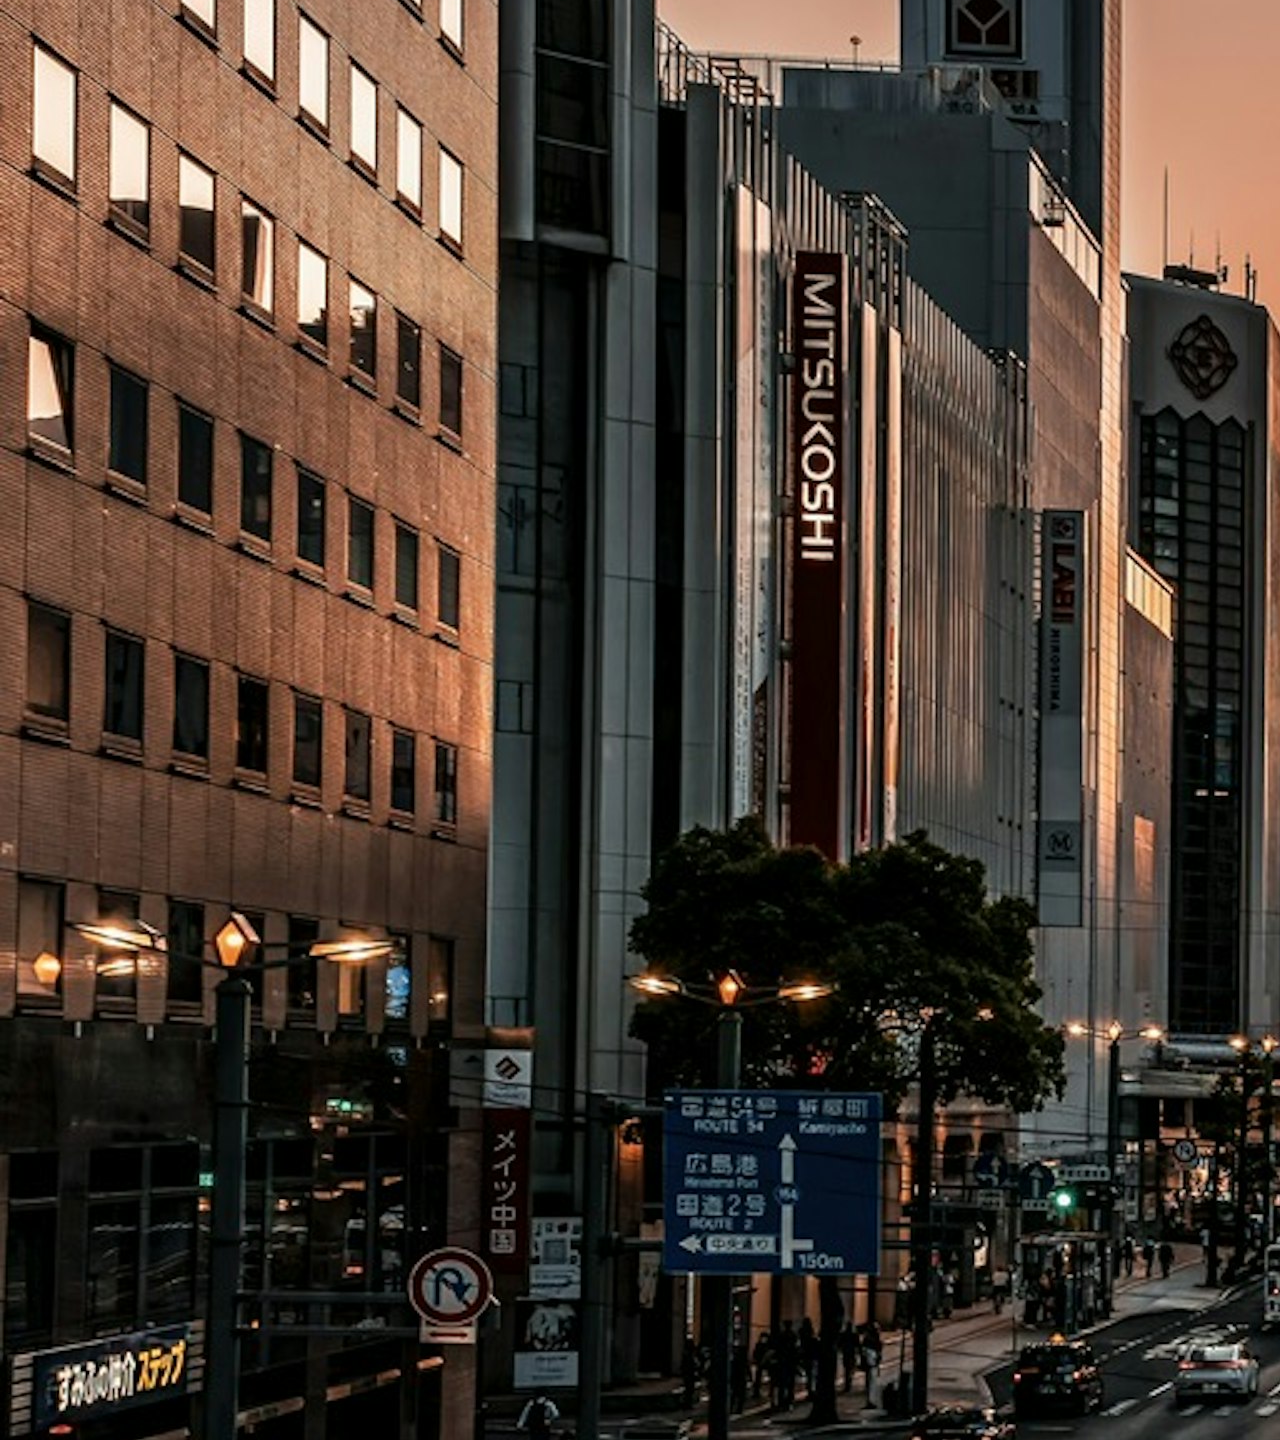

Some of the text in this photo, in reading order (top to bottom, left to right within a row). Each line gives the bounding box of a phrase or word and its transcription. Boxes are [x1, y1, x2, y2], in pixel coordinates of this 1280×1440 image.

[800, 272, 837, 561] MITSUKOSHI
[1052, 543, 1075, 624] LABI
[1050, 628, 1061, 711] HIROSHIMA
[693, 1118, 765, 1135] ROUTE 54
[798, 1120, 868, 1137] Kamiyacho
[684, 1152, 759, 1177] 広島港
[488, 1128, 517, 1255] メイツ中国
[675, 1193, 767, 1217] 国道2号
[688, 1216, 754, 1232] ROUTE 2
[798, 1252, 845, 1270] 150m
[55, 1338, 187, 1413] すみふの仲介 ステップ
